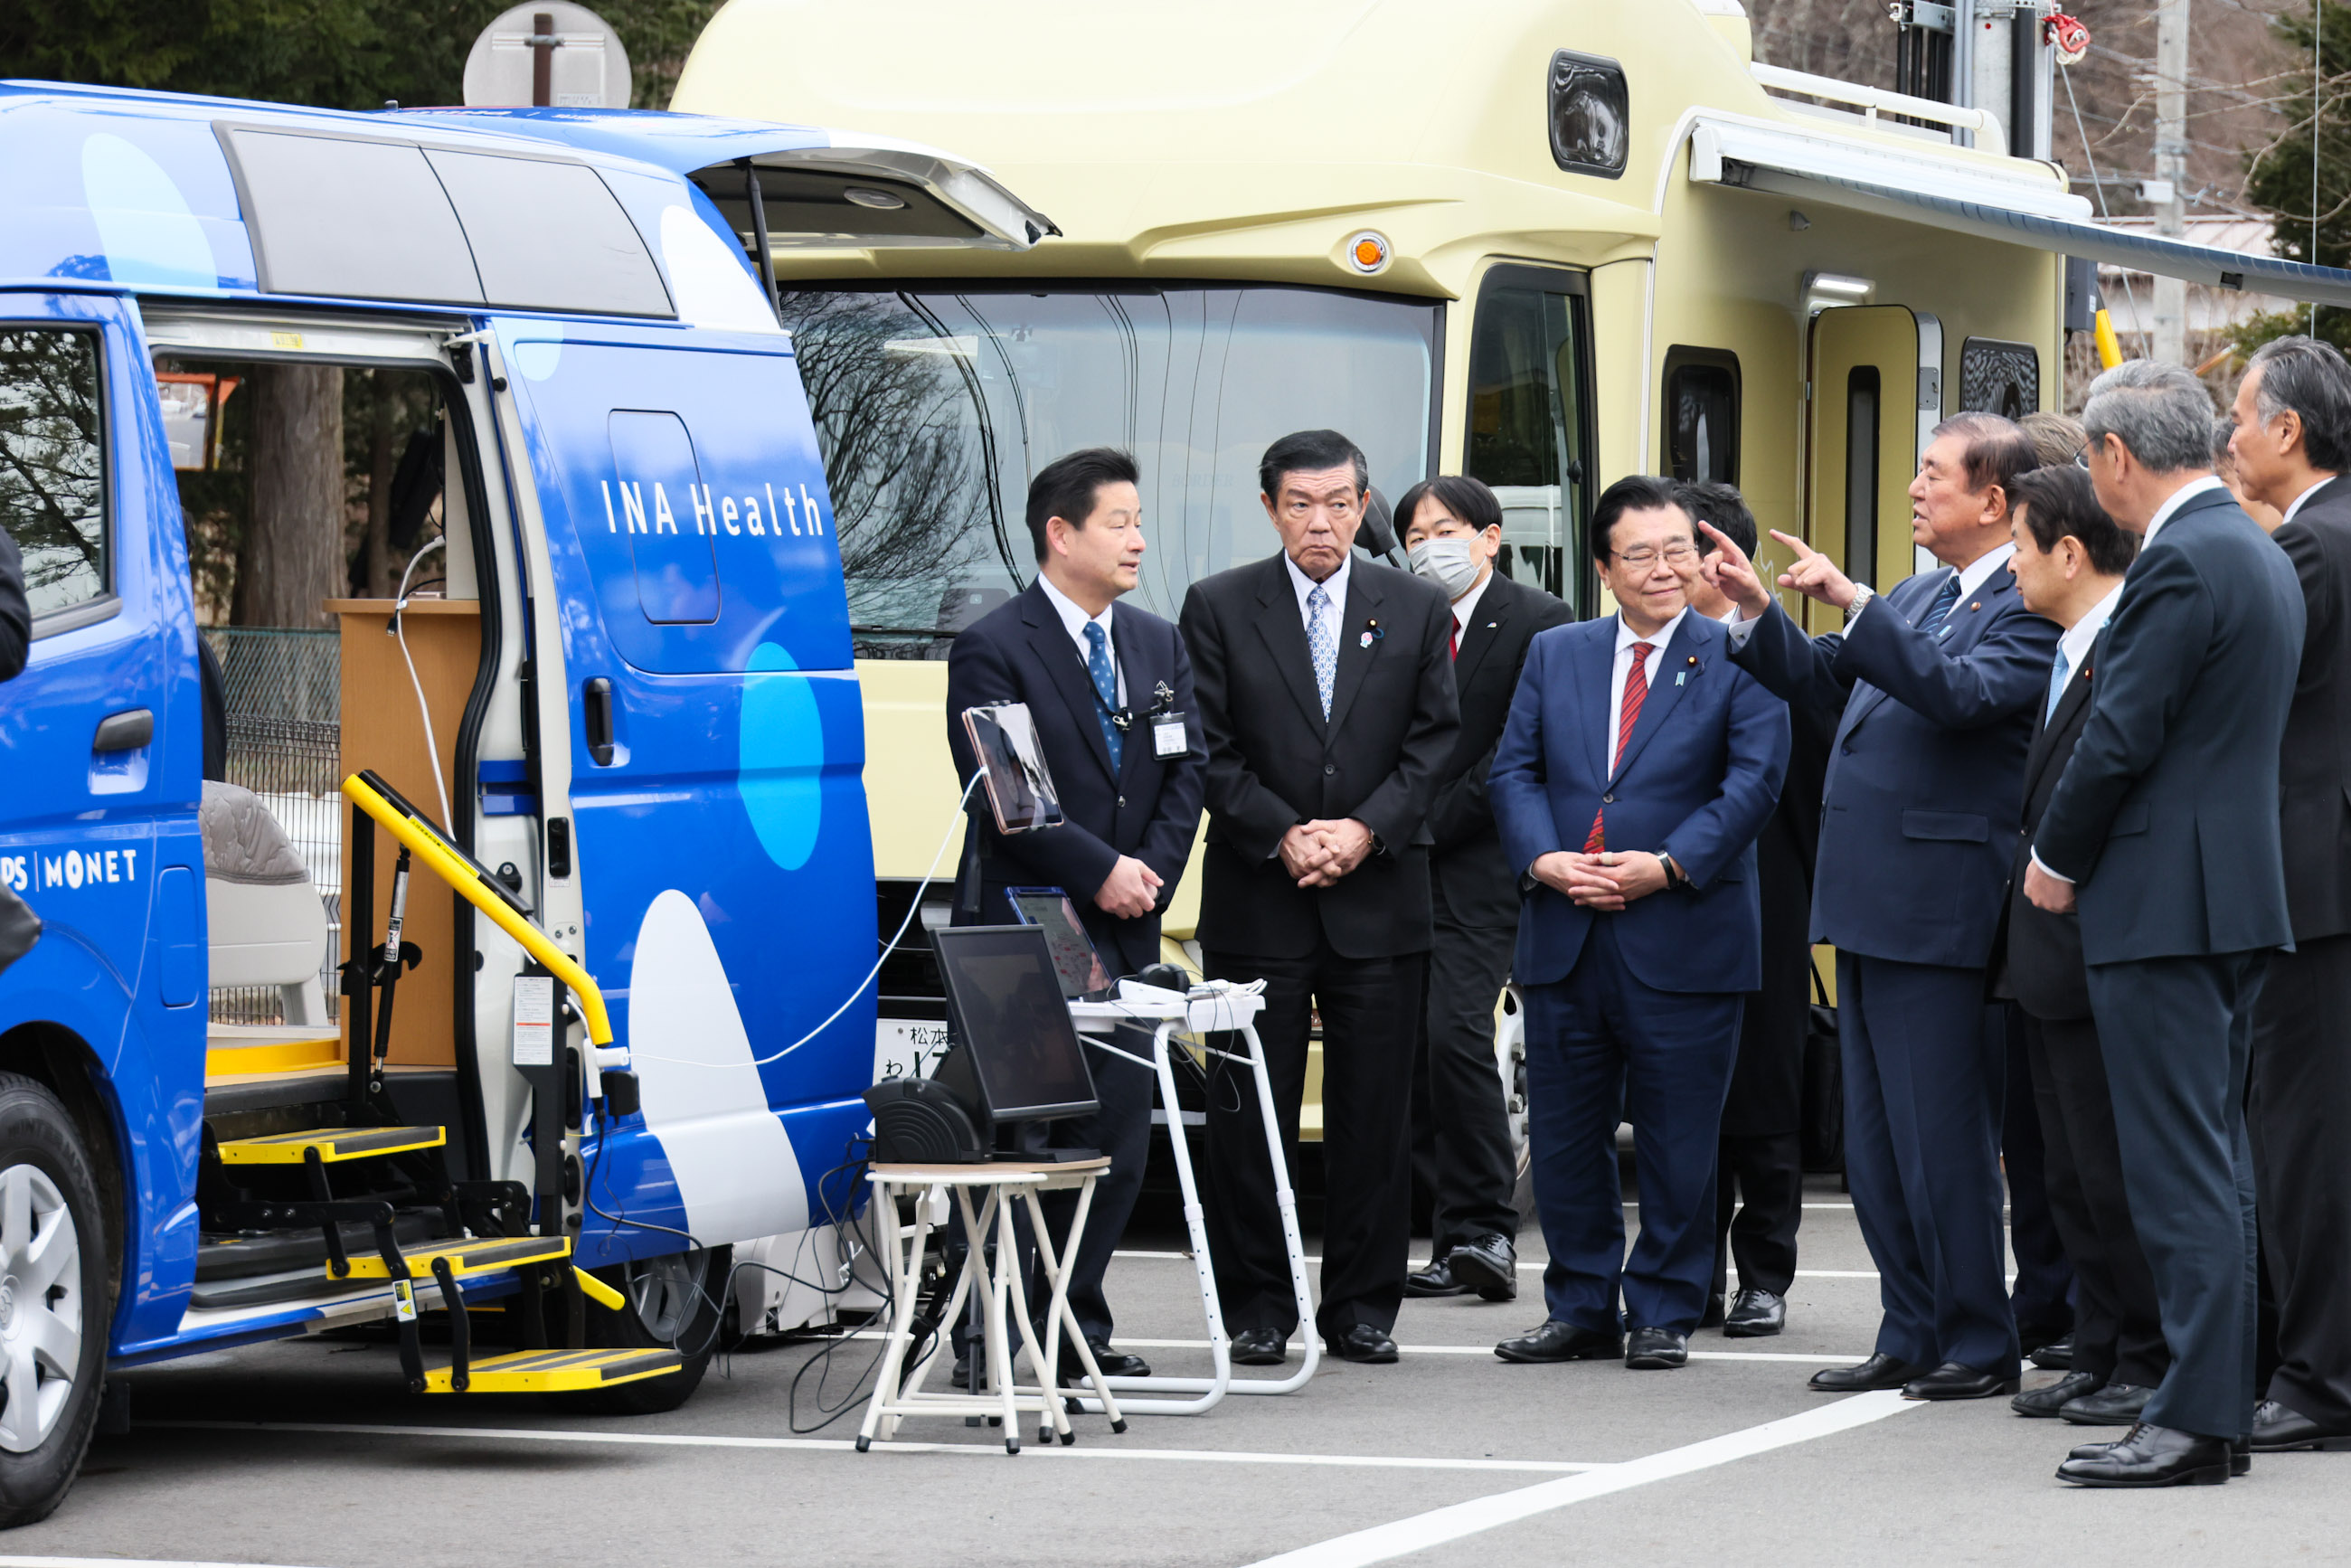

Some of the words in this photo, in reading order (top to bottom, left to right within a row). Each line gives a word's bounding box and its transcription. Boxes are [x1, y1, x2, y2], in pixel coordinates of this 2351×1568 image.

[600, 480, 678, 534] INA
[689, 482, 824, 536] Health
[44, 849, 137, 889] MONET
[910, 1026, 949, 1046] 松本
